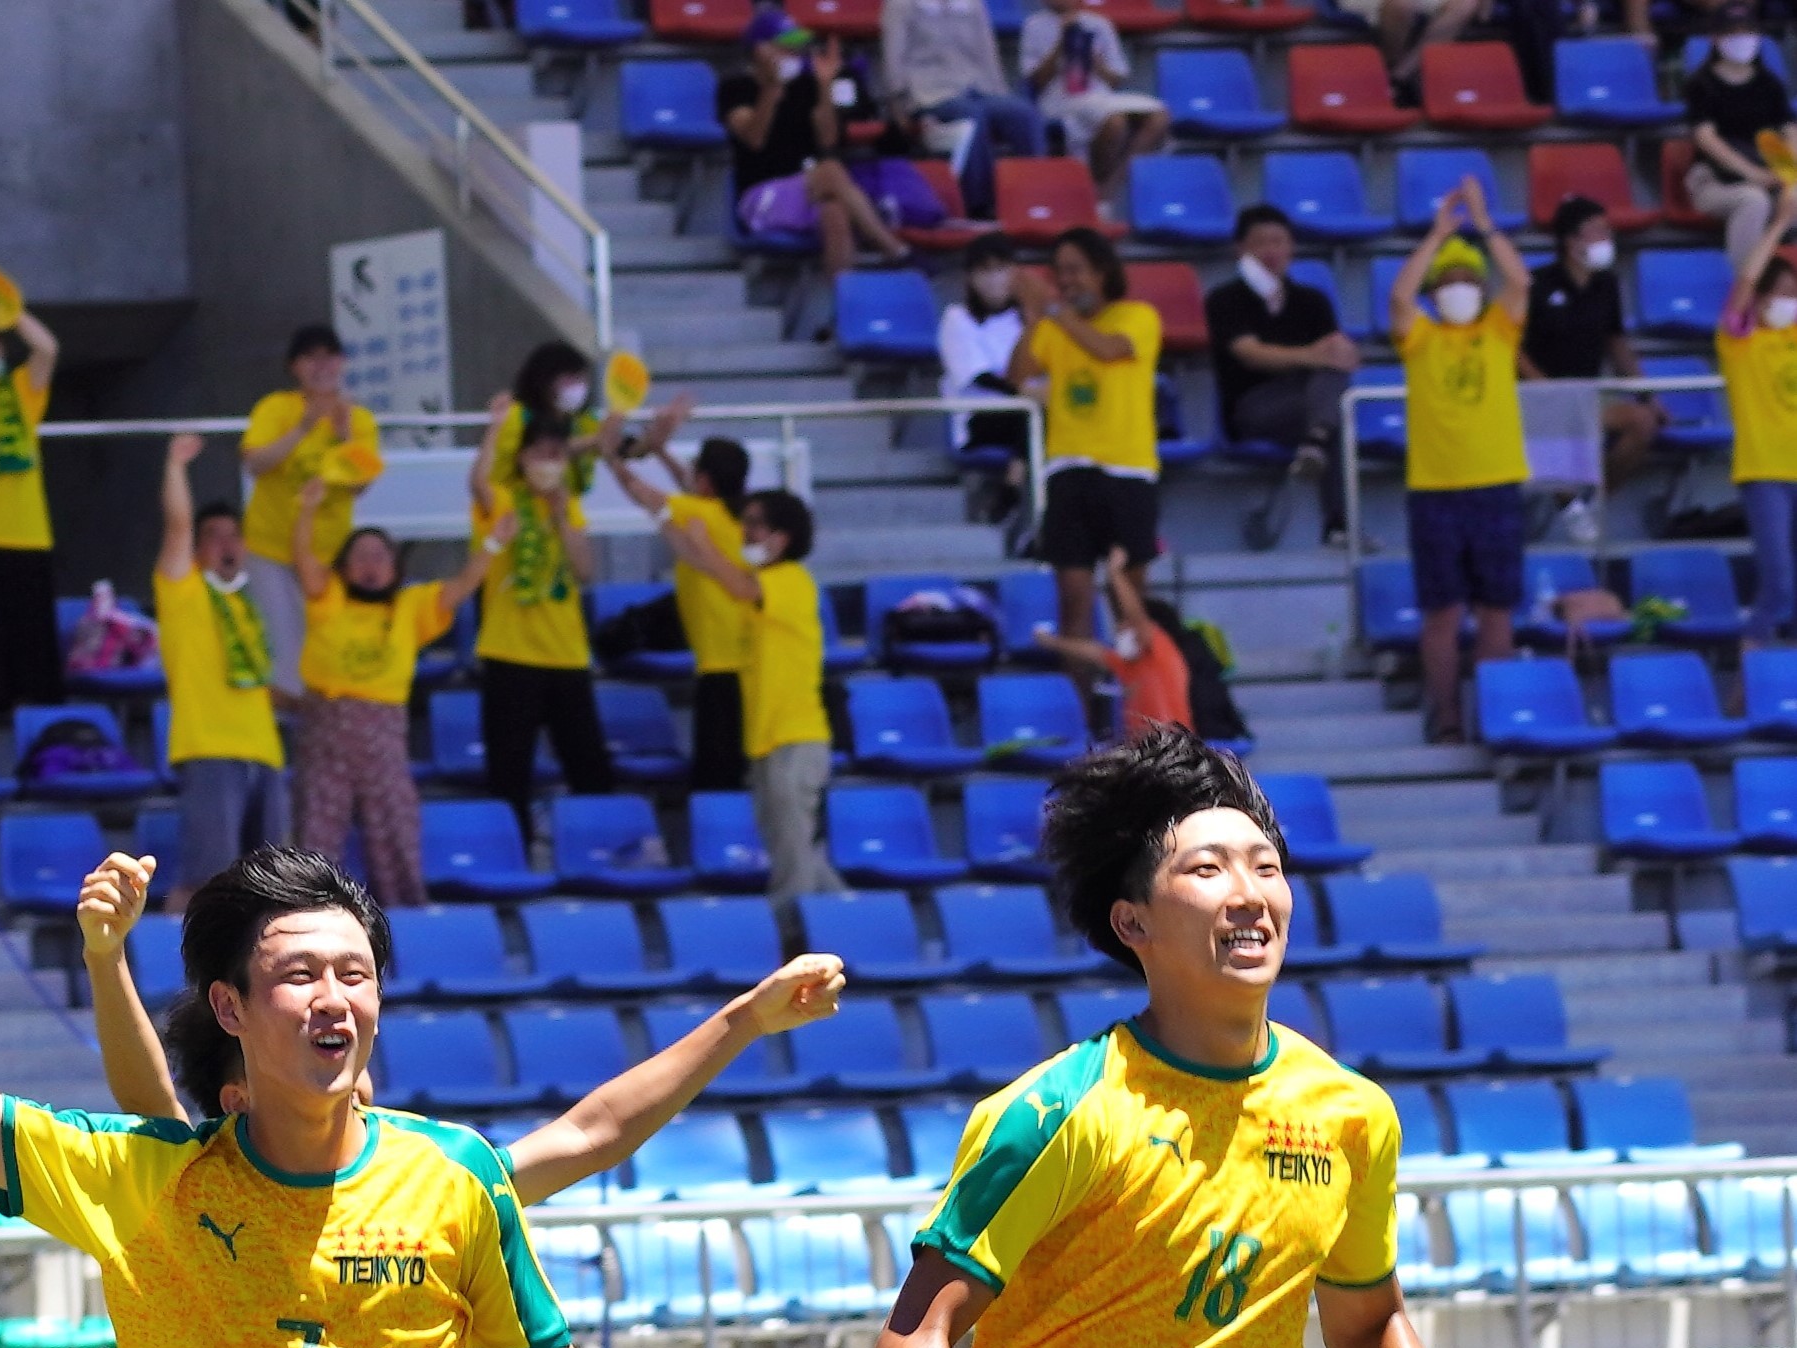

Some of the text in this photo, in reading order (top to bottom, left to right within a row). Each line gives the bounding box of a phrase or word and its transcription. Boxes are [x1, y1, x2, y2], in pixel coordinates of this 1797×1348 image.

[1264, 1150, 1332, 1186] TEIKYO
[332, 1255, 426, 1286] TEIKYO
[1174, 1228, 1263, 1327] 18
